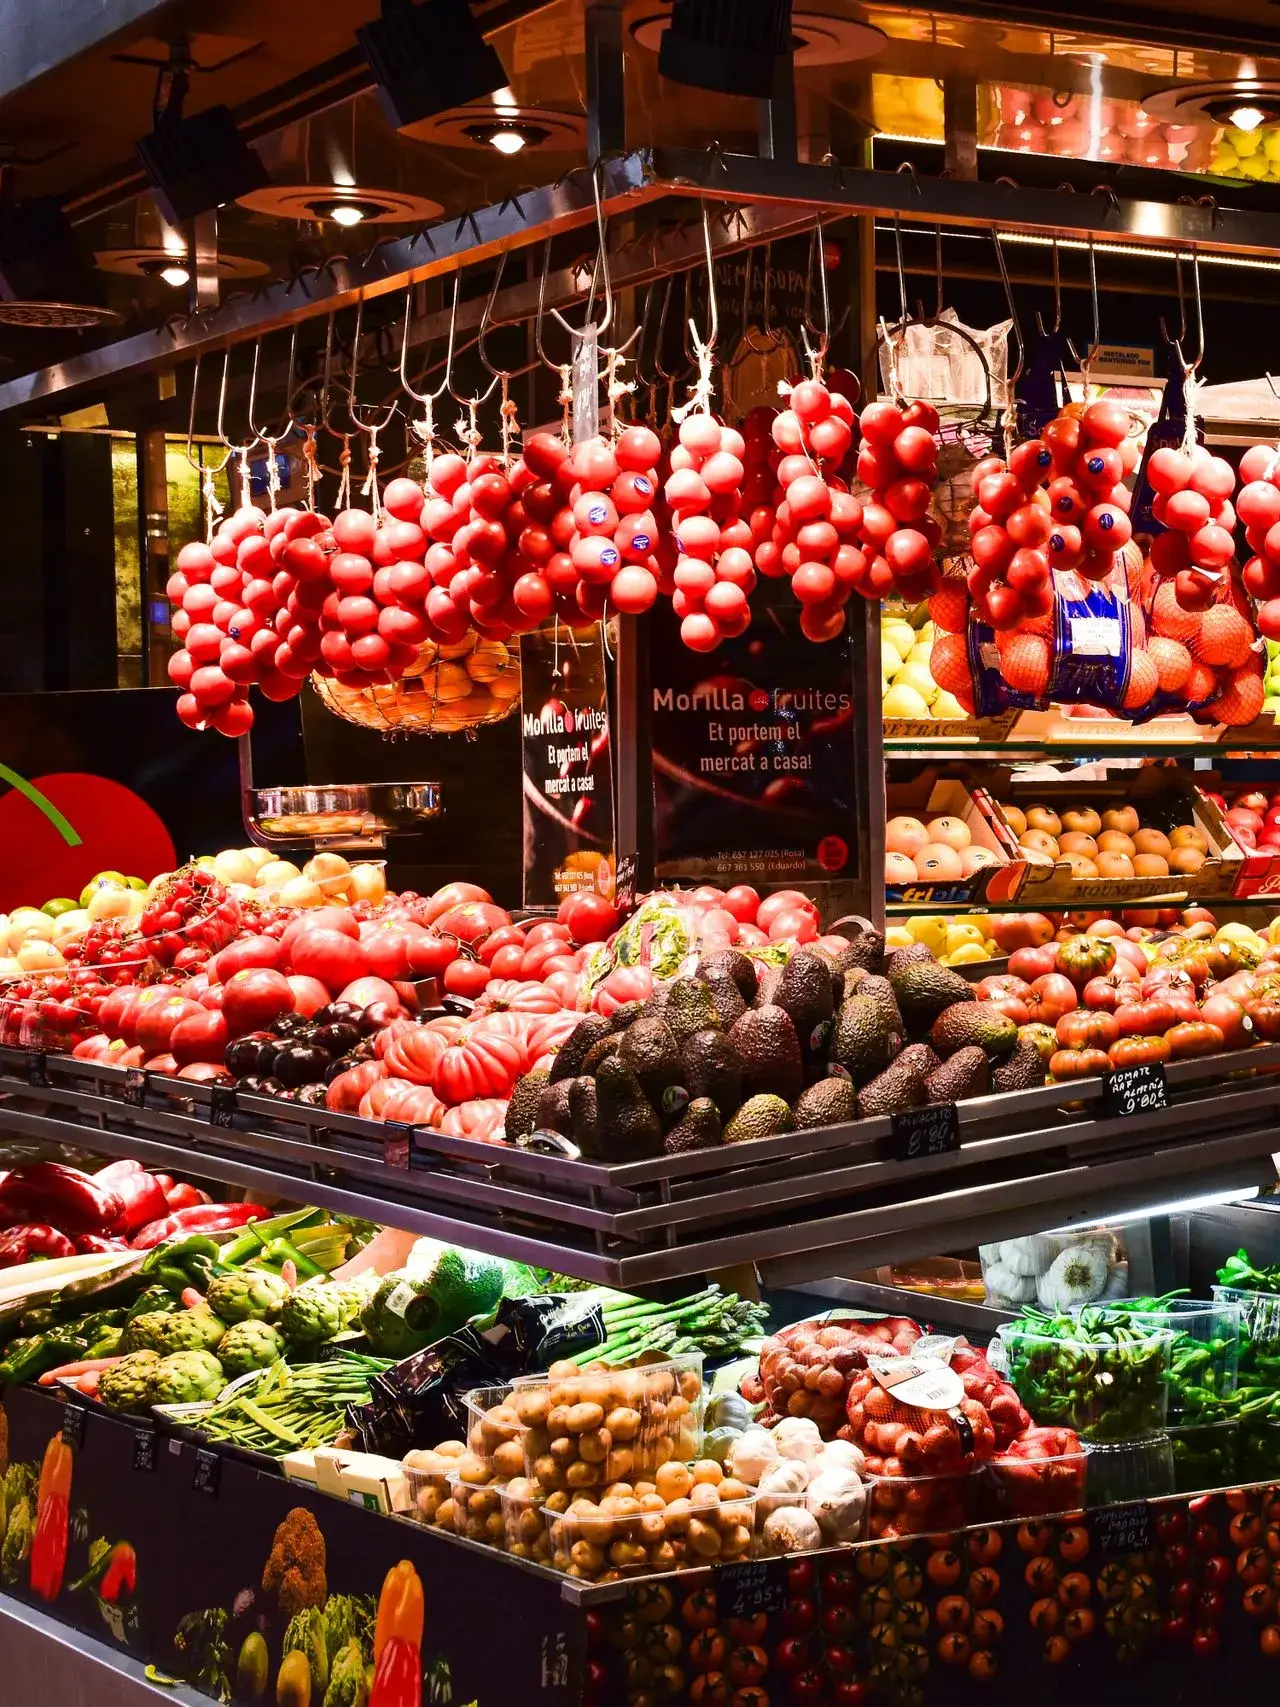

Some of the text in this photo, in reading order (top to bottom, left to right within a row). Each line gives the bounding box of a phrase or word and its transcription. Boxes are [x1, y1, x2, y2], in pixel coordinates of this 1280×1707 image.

[653, 687, 850, 712] Morilla fruites
[523, 707, 607, 738] Morilla fruites
[708, 722, 801, 746] Et portem el
[548, 742, 589, 767] Et portem el
[700, 753, 812, 772] mercat a casa!
[544, 774, 594, 794] mercat a casa!
[749, 850, 763, 859] 127
[781, 849, 805, 858] (Rosa)
[750, 862, 765, 871] 550
[768, 861, 806, 871] (Eduardo)
[1109, 1067, 1150, 1084] TOMATE
[1112, 1080, 1132, 1093] RAF
